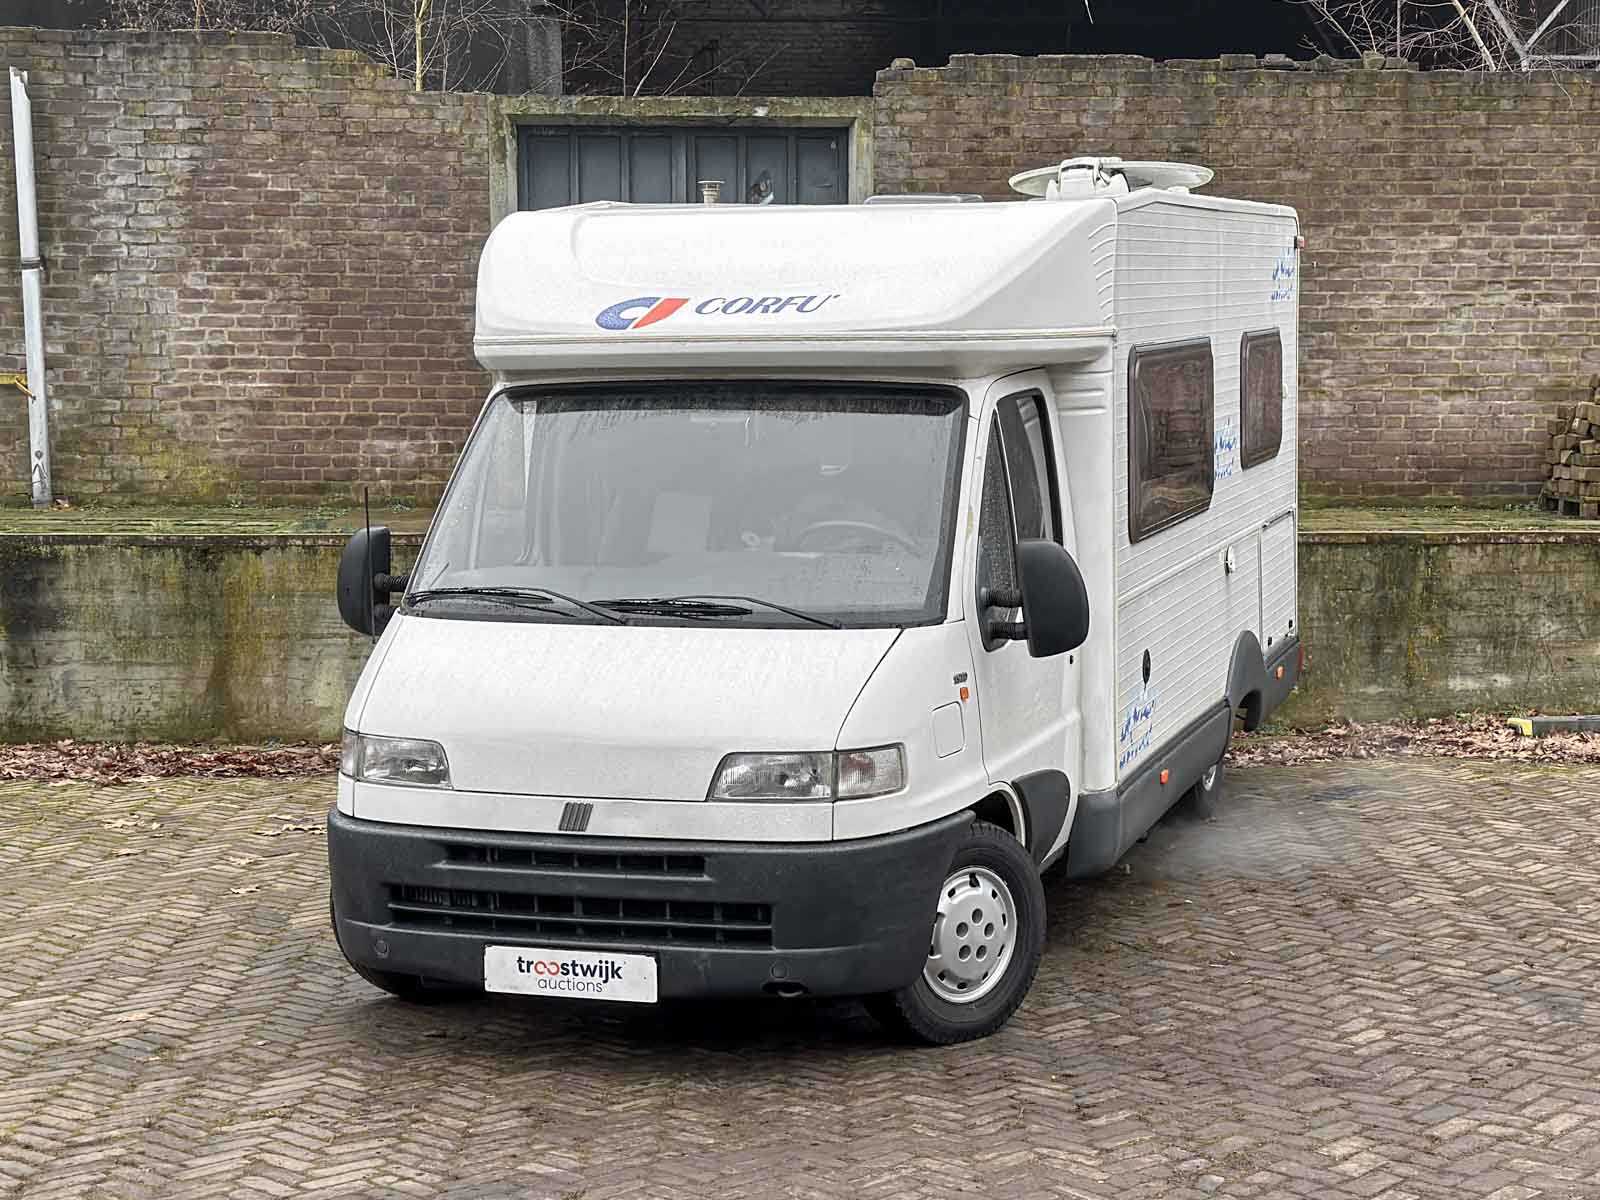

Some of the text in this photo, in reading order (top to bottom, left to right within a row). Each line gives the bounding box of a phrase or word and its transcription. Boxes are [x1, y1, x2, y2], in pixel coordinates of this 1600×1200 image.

[694, 294, 832, 315] CORFU
[516, 956, 623, 983] troostwijk
[537, 978, 603, 992] auctions
